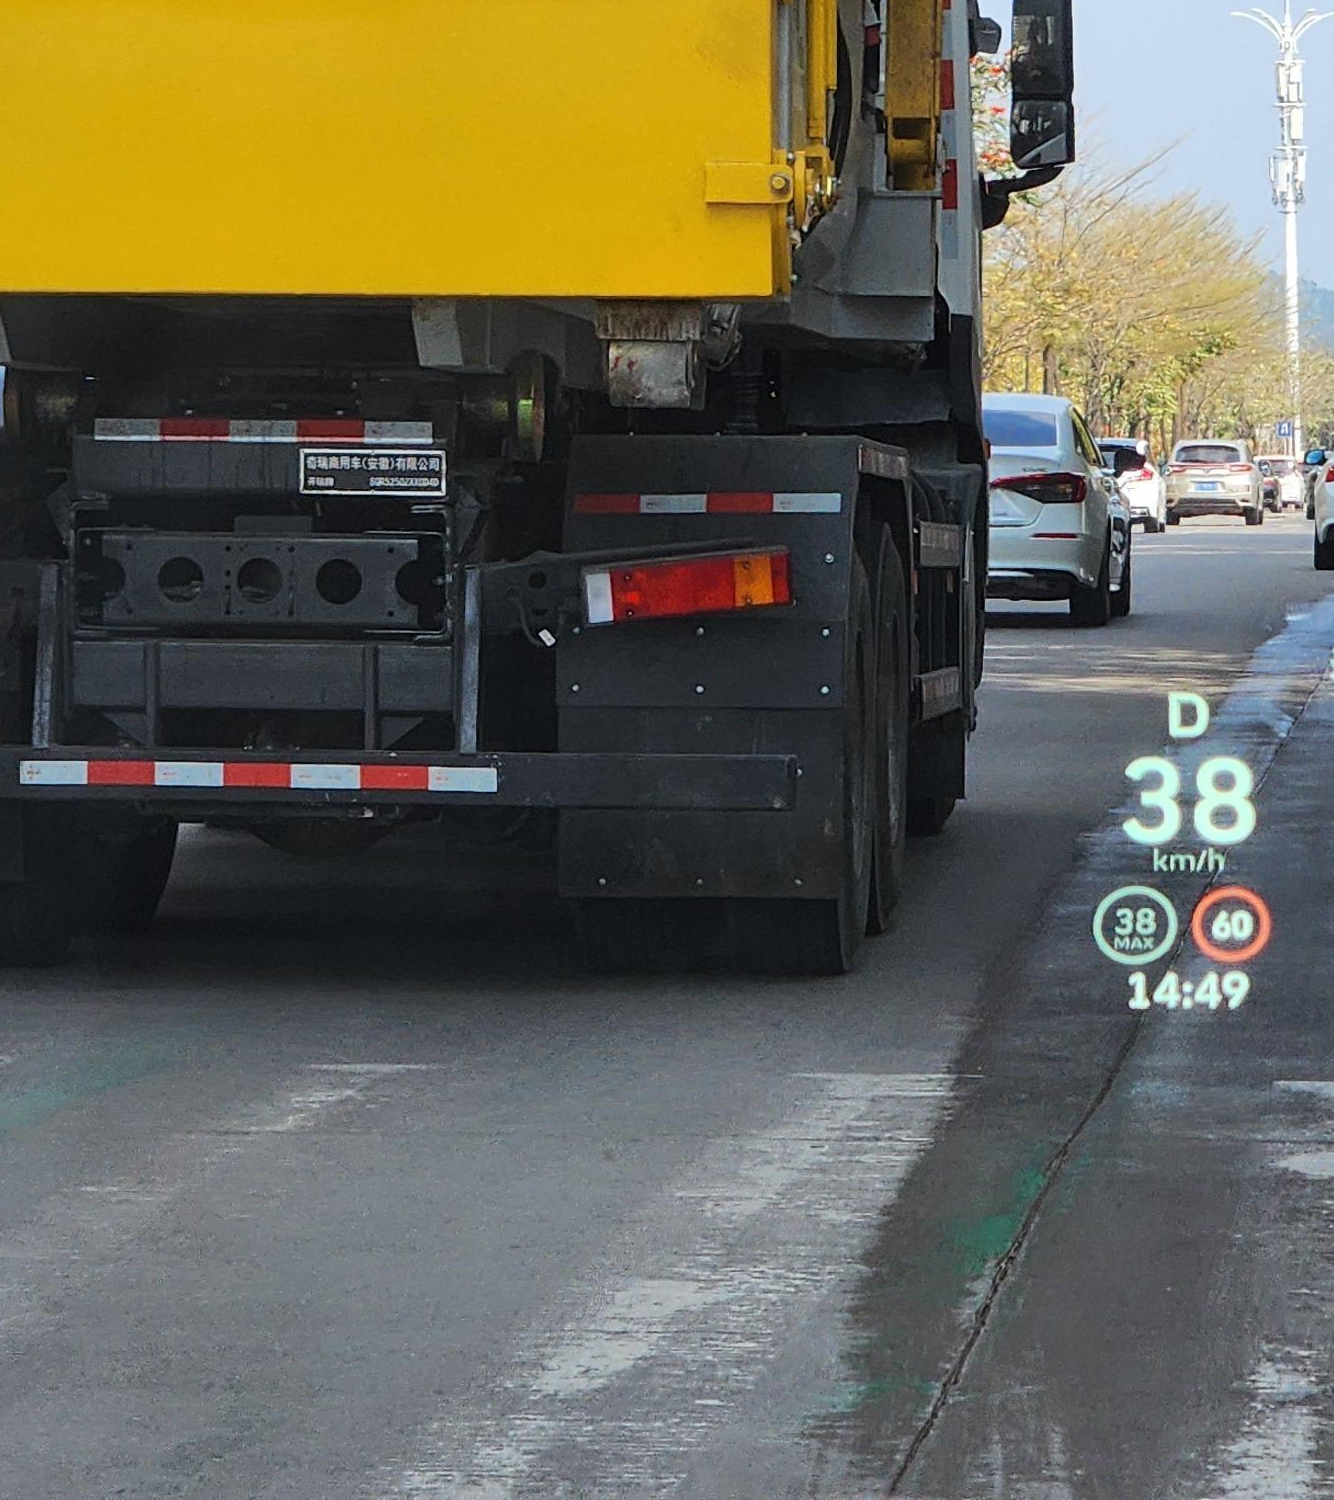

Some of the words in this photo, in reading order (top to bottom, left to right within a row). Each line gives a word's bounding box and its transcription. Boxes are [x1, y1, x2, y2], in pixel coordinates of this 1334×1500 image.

[1168, 691, 1211, 739] D
[1122, 756, 1257, 846] 38
[1153, 847, 1226, 874] km/h
[1113, 907, 1156, 935] 38
[1211, 909, 1253, 941] 60
[1114, 937, 1155, 952] MAX
[1127, 971, 1251, 1010] 14:49
